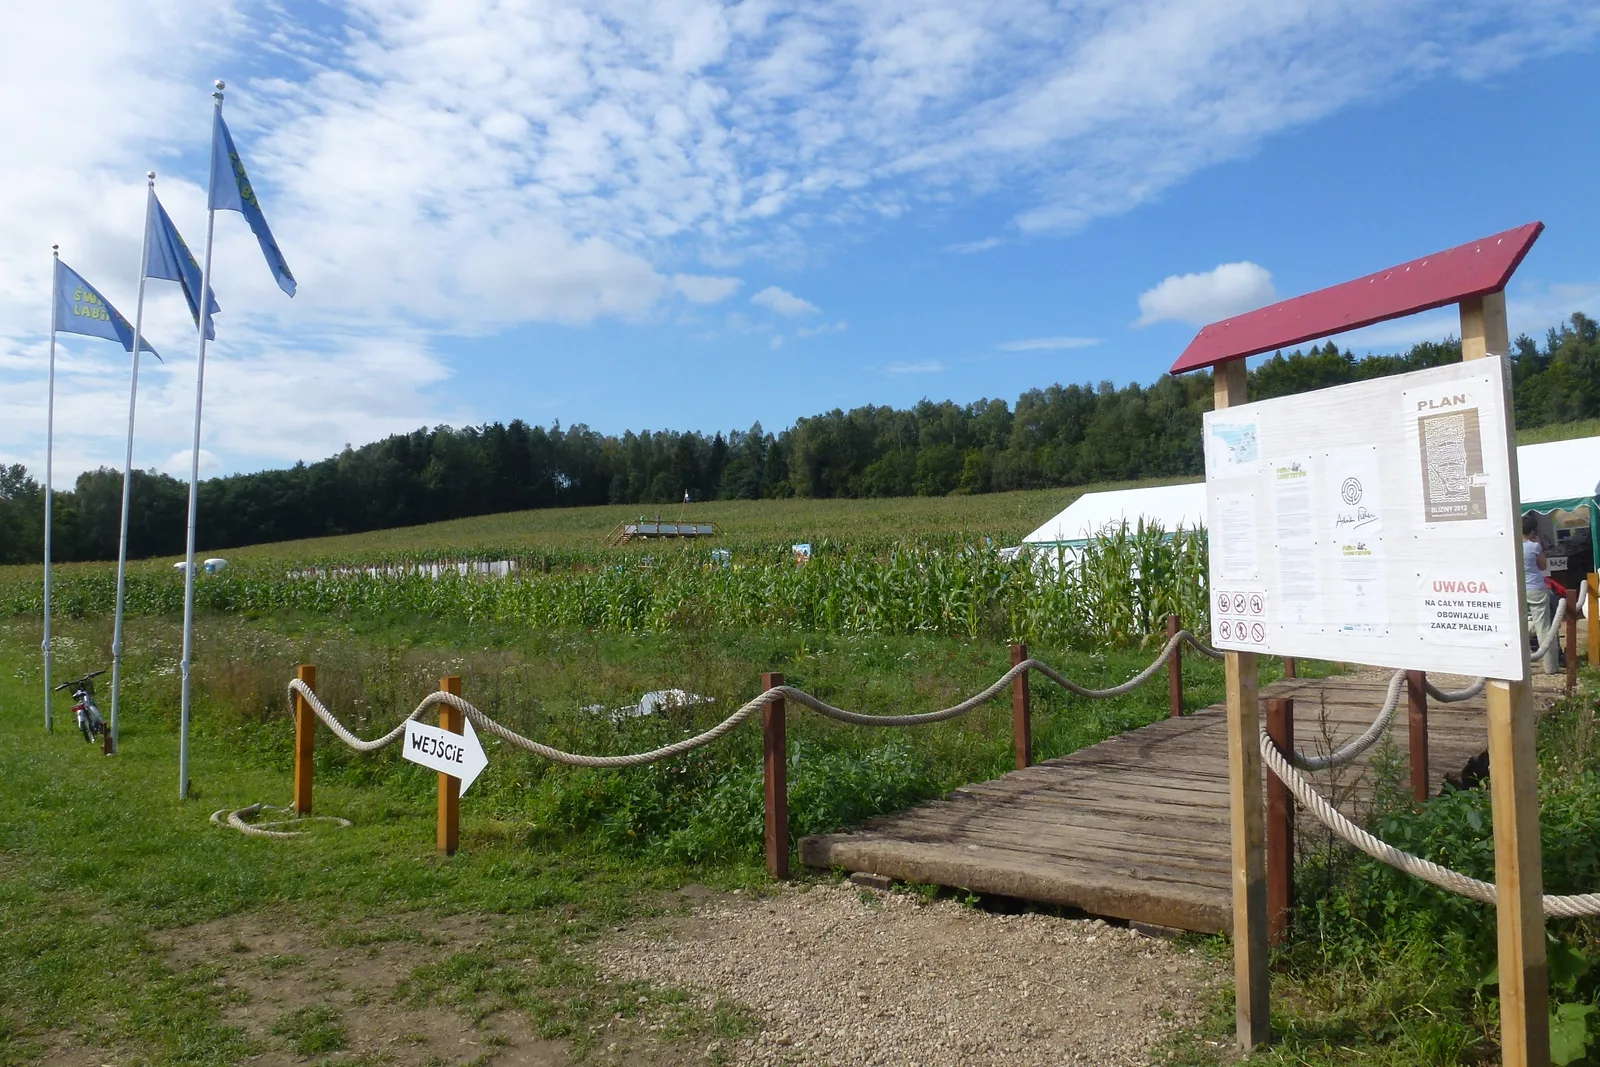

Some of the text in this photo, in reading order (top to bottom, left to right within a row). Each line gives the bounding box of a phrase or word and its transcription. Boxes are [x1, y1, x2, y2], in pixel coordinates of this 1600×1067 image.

[1417, 394, 1466, 411] PLAN
[1453, 504, 1468, 512] 2012
[1433, 580, 1489, 594] UWAGA
[1424, 599, 1502, 609] NA CAŁYM TERENIE
[1436, 611, 1490, 621] OBOWIĄZUJE
[1430, 622, 1457, 630] ZAKAZ
[1458, 623, 1493, 632] PALENIA
